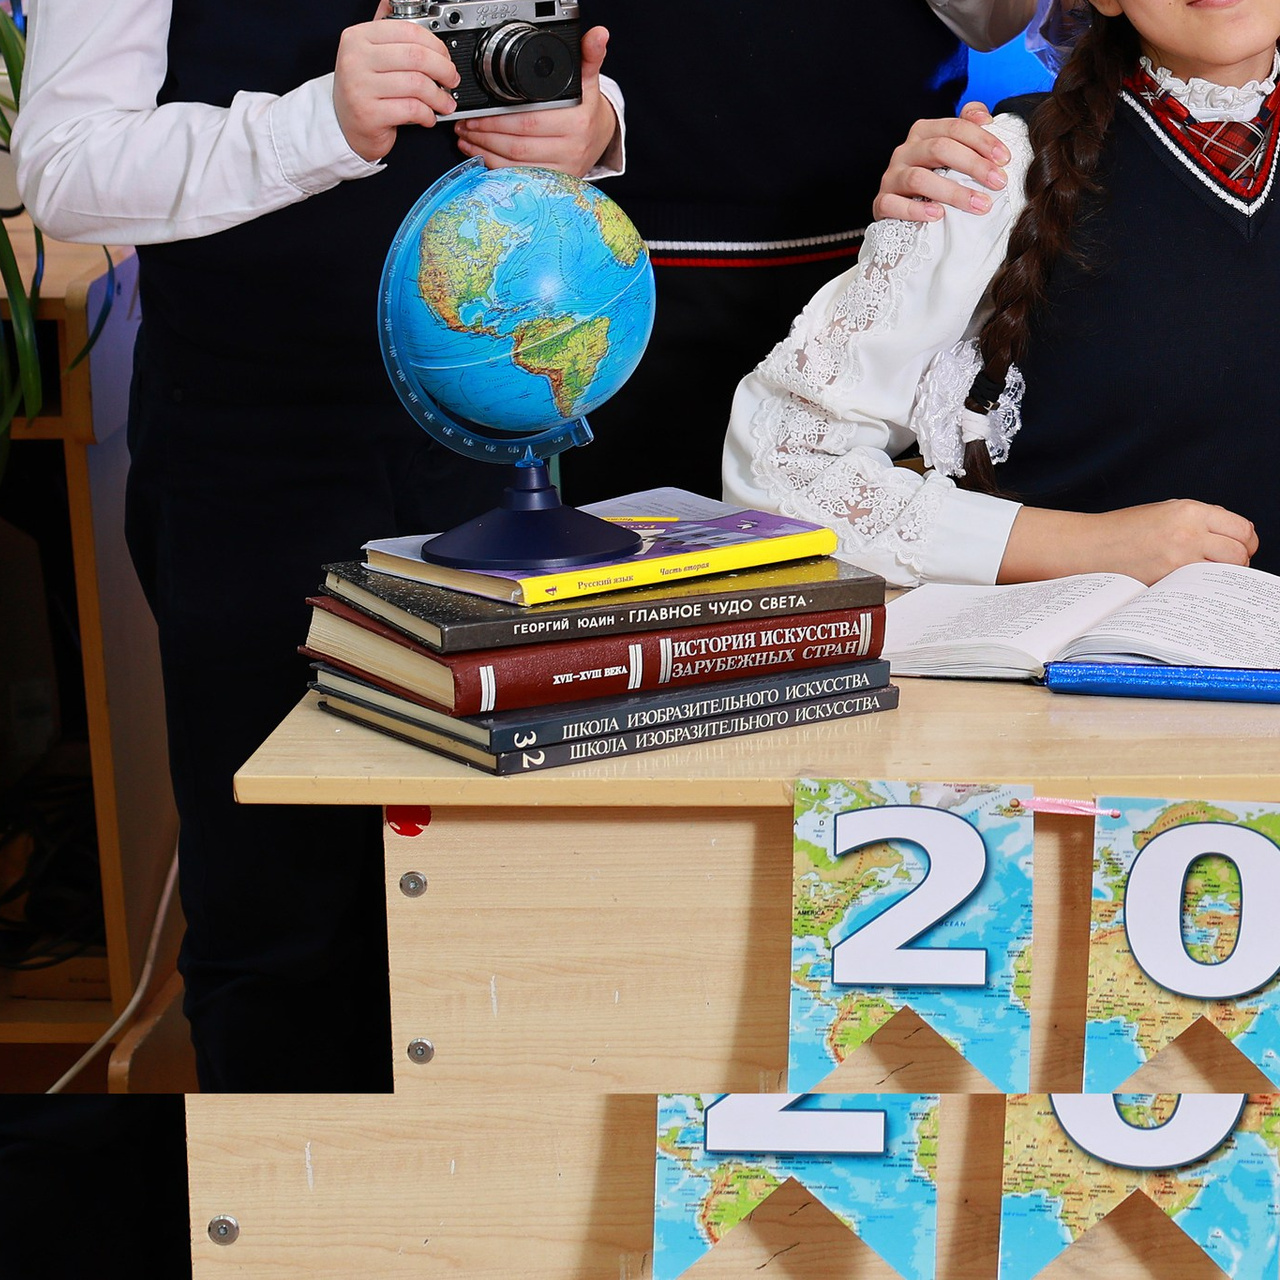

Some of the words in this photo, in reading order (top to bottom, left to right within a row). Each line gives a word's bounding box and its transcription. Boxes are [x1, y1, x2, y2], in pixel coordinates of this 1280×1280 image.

[577, 577, 612, 590] Русский
[613, 574, 634, 585] язык
[660, 567, 683, 576] Часть
[683, 561, 710, 572] вторая
[513, 617, 570, 635] ГЕОРГИЙ
[577, 615, 615, 629] ЮДИН
[628, 603, 702, 623] ГЛАВНОЕ
[708, 599, 753, 616] ЧУДО
[759, 595, 807, 610] СВЕТА
[671, 648, 796, 678] ЗАРУБЕЖНЫХ
[802, 640, 859, 660] СТРАН
[672, 632, 757, 659] ИСТОРИЯ
[760, 620, 862, 647] ИСКУССТВА
[604, 665, 629, 678] ВЕКА
[513, 730, 537, 749] 3
[561, 717, 620, 740] ШКОЛА
[627, 688, 780, 729] ИЗОБРАЗИТЕЛЬНОГО
[785, 672, 871, 701] ИСКУССТВА
[522, 750, 546, 769] 2
[570, 736, 628, 760] ШКОЛА
[634, 710, 789, 748] ИЗОБРАЗИТЕЛЬНОГО
[794, 695, 881, 722] ИСКУССТВА
[832, 804, 989, 988] 2
